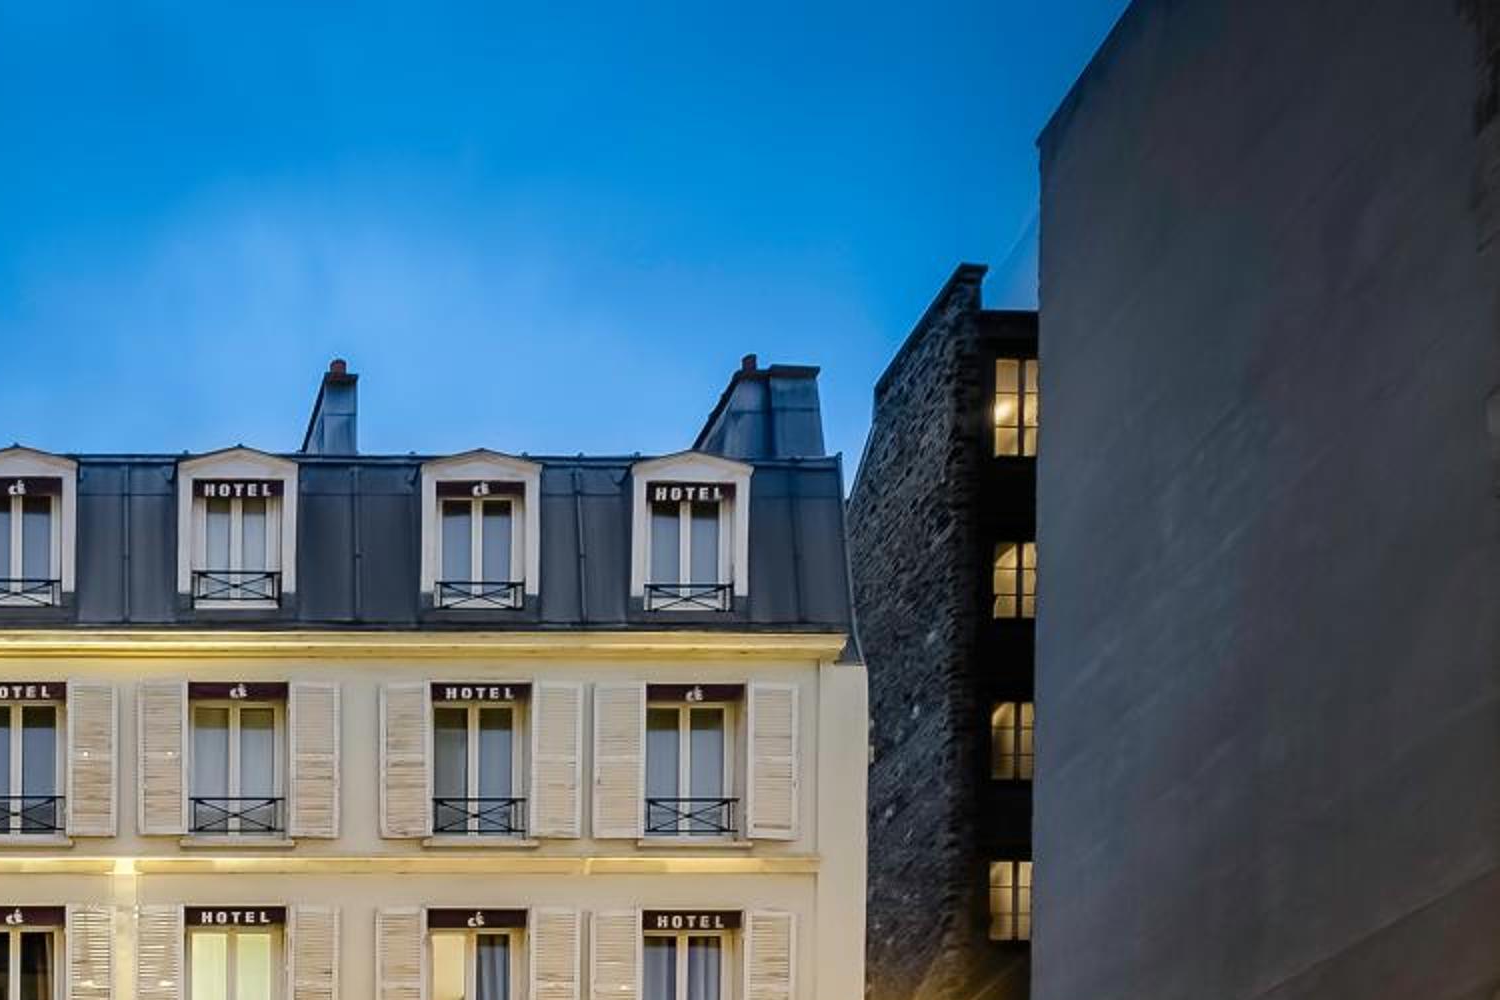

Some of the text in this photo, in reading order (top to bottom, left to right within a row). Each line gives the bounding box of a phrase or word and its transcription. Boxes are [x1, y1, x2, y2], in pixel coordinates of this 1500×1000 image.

[204, 483, 272, 497] HOTEL
[655, 486, 723, 501] HOTEL
[446, 687, 515, 699] HOTEL
[201, 911, 270, 924] HOTEL
[657, 915, 725, 929] HOTEL
